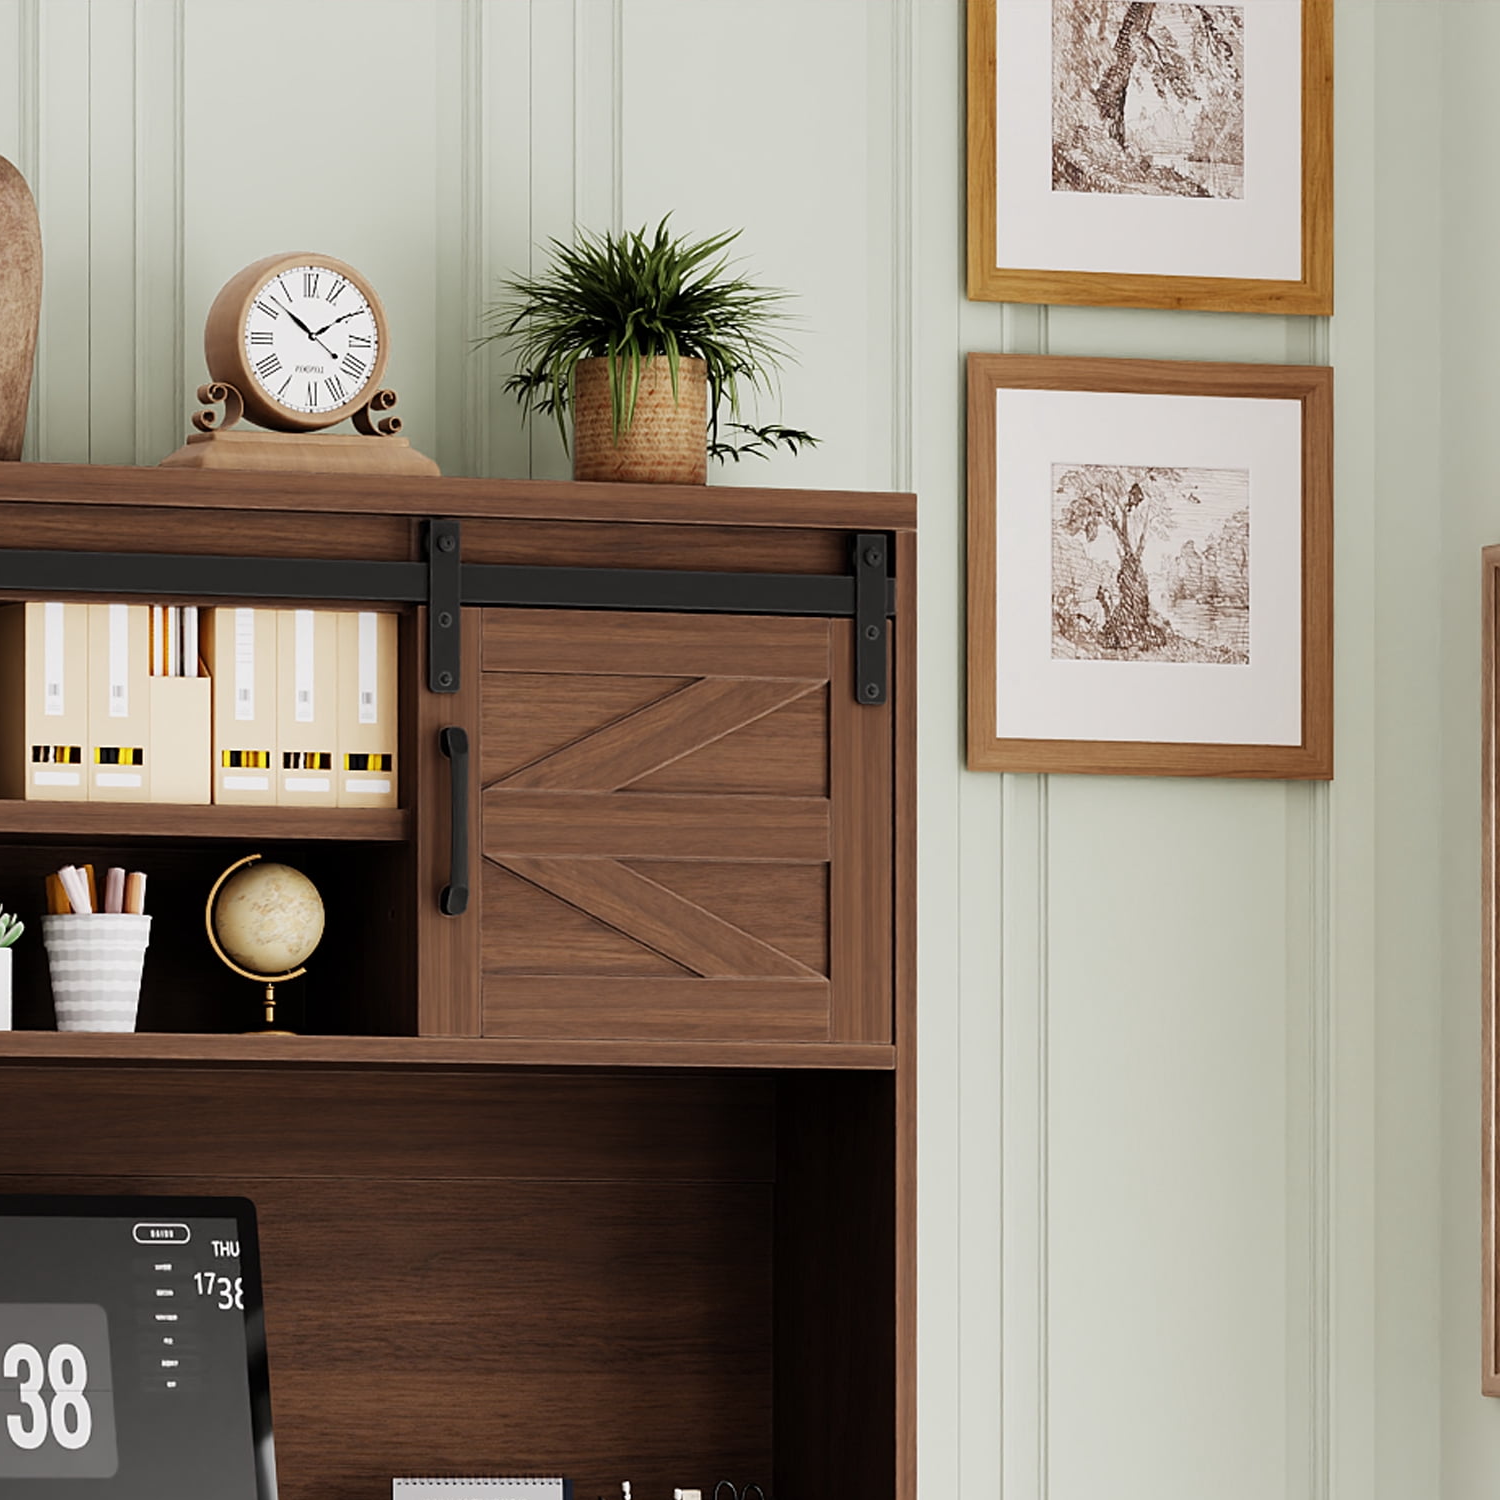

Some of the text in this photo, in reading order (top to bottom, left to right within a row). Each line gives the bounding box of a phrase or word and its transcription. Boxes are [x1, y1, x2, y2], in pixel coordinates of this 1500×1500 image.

[211, 1240, 240, 1257] THU
[194, 1272, 216, 1295] 17
[3, 1343, 93, 1450] 38
